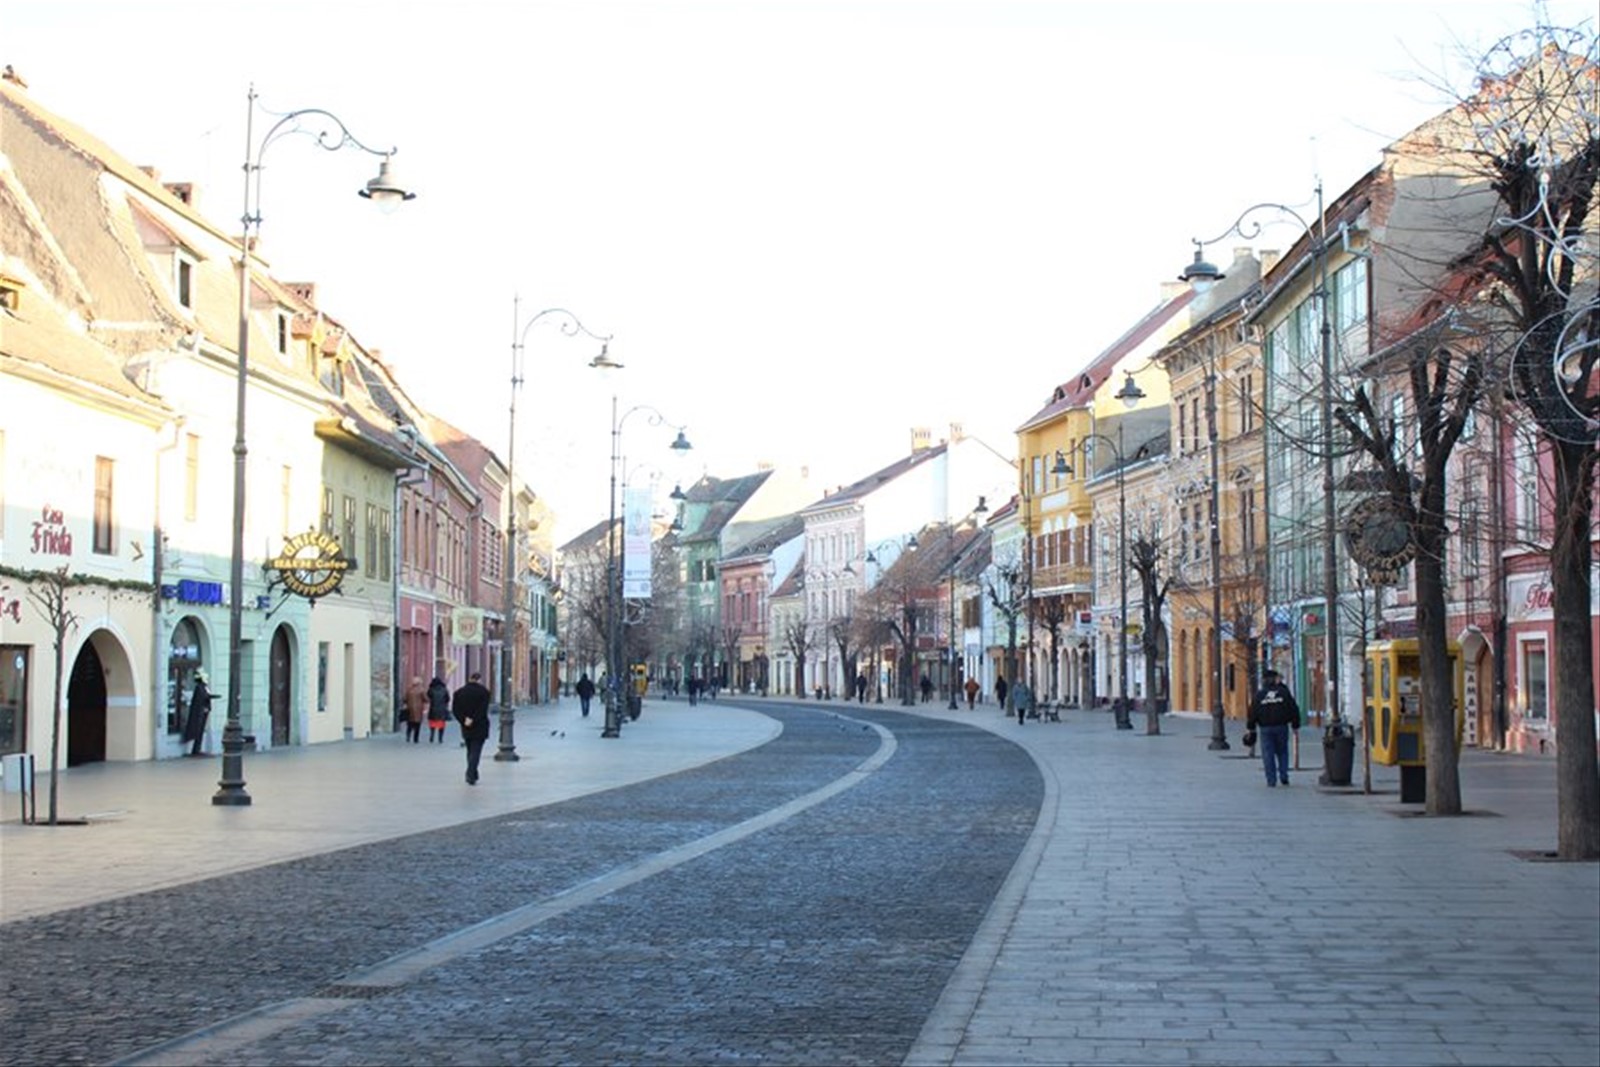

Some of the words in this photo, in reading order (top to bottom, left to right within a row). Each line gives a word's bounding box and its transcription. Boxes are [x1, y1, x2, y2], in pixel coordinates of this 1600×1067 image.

[283, 534, 339, 557] UNICUM
[283, 571, 341, 595] TREFFPUNKT
[1467, 674, 1476, 742] AMANET
